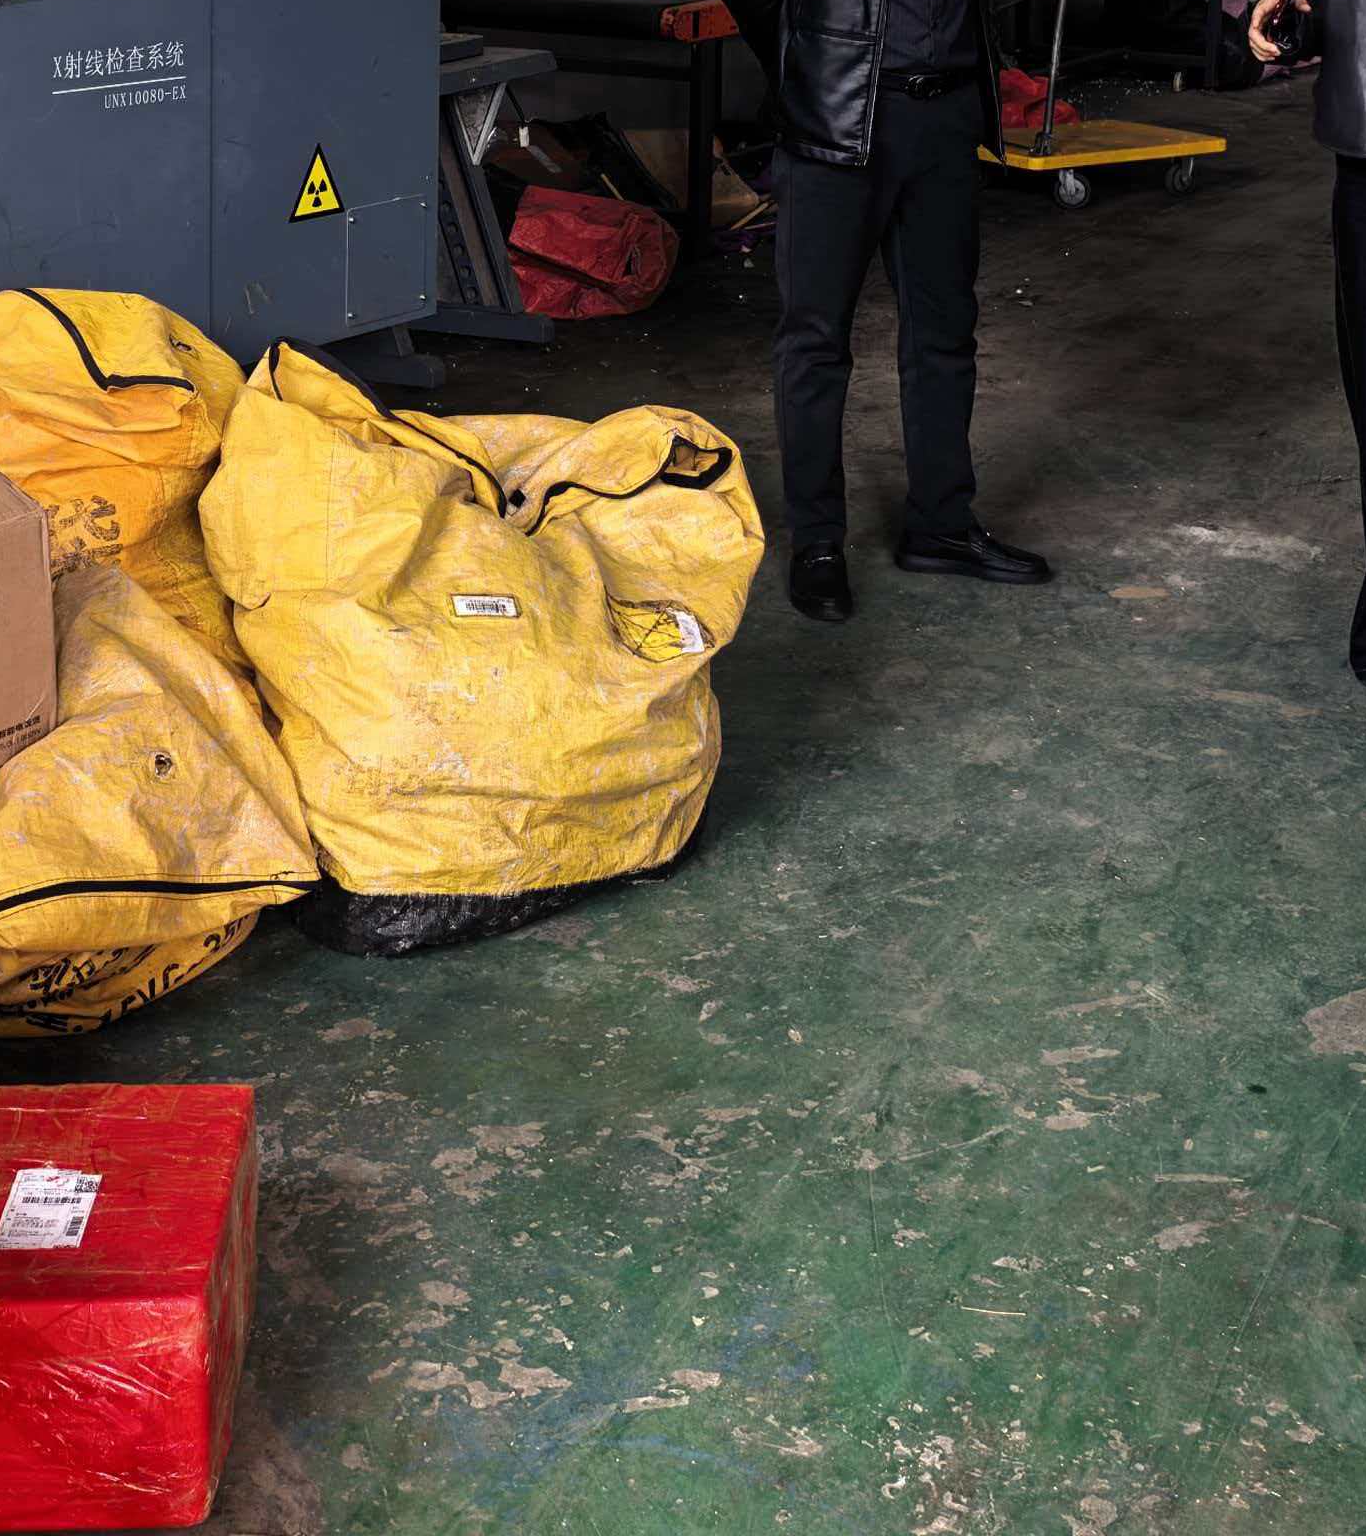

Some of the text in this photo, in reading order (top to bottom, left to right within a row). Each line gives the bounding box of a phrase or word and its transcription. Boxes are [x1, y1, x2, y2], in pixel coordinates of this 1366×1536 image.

[52, 41, 185, 79] X射线检查系统
[104, 84, 186, 109] UNX10080-EX
